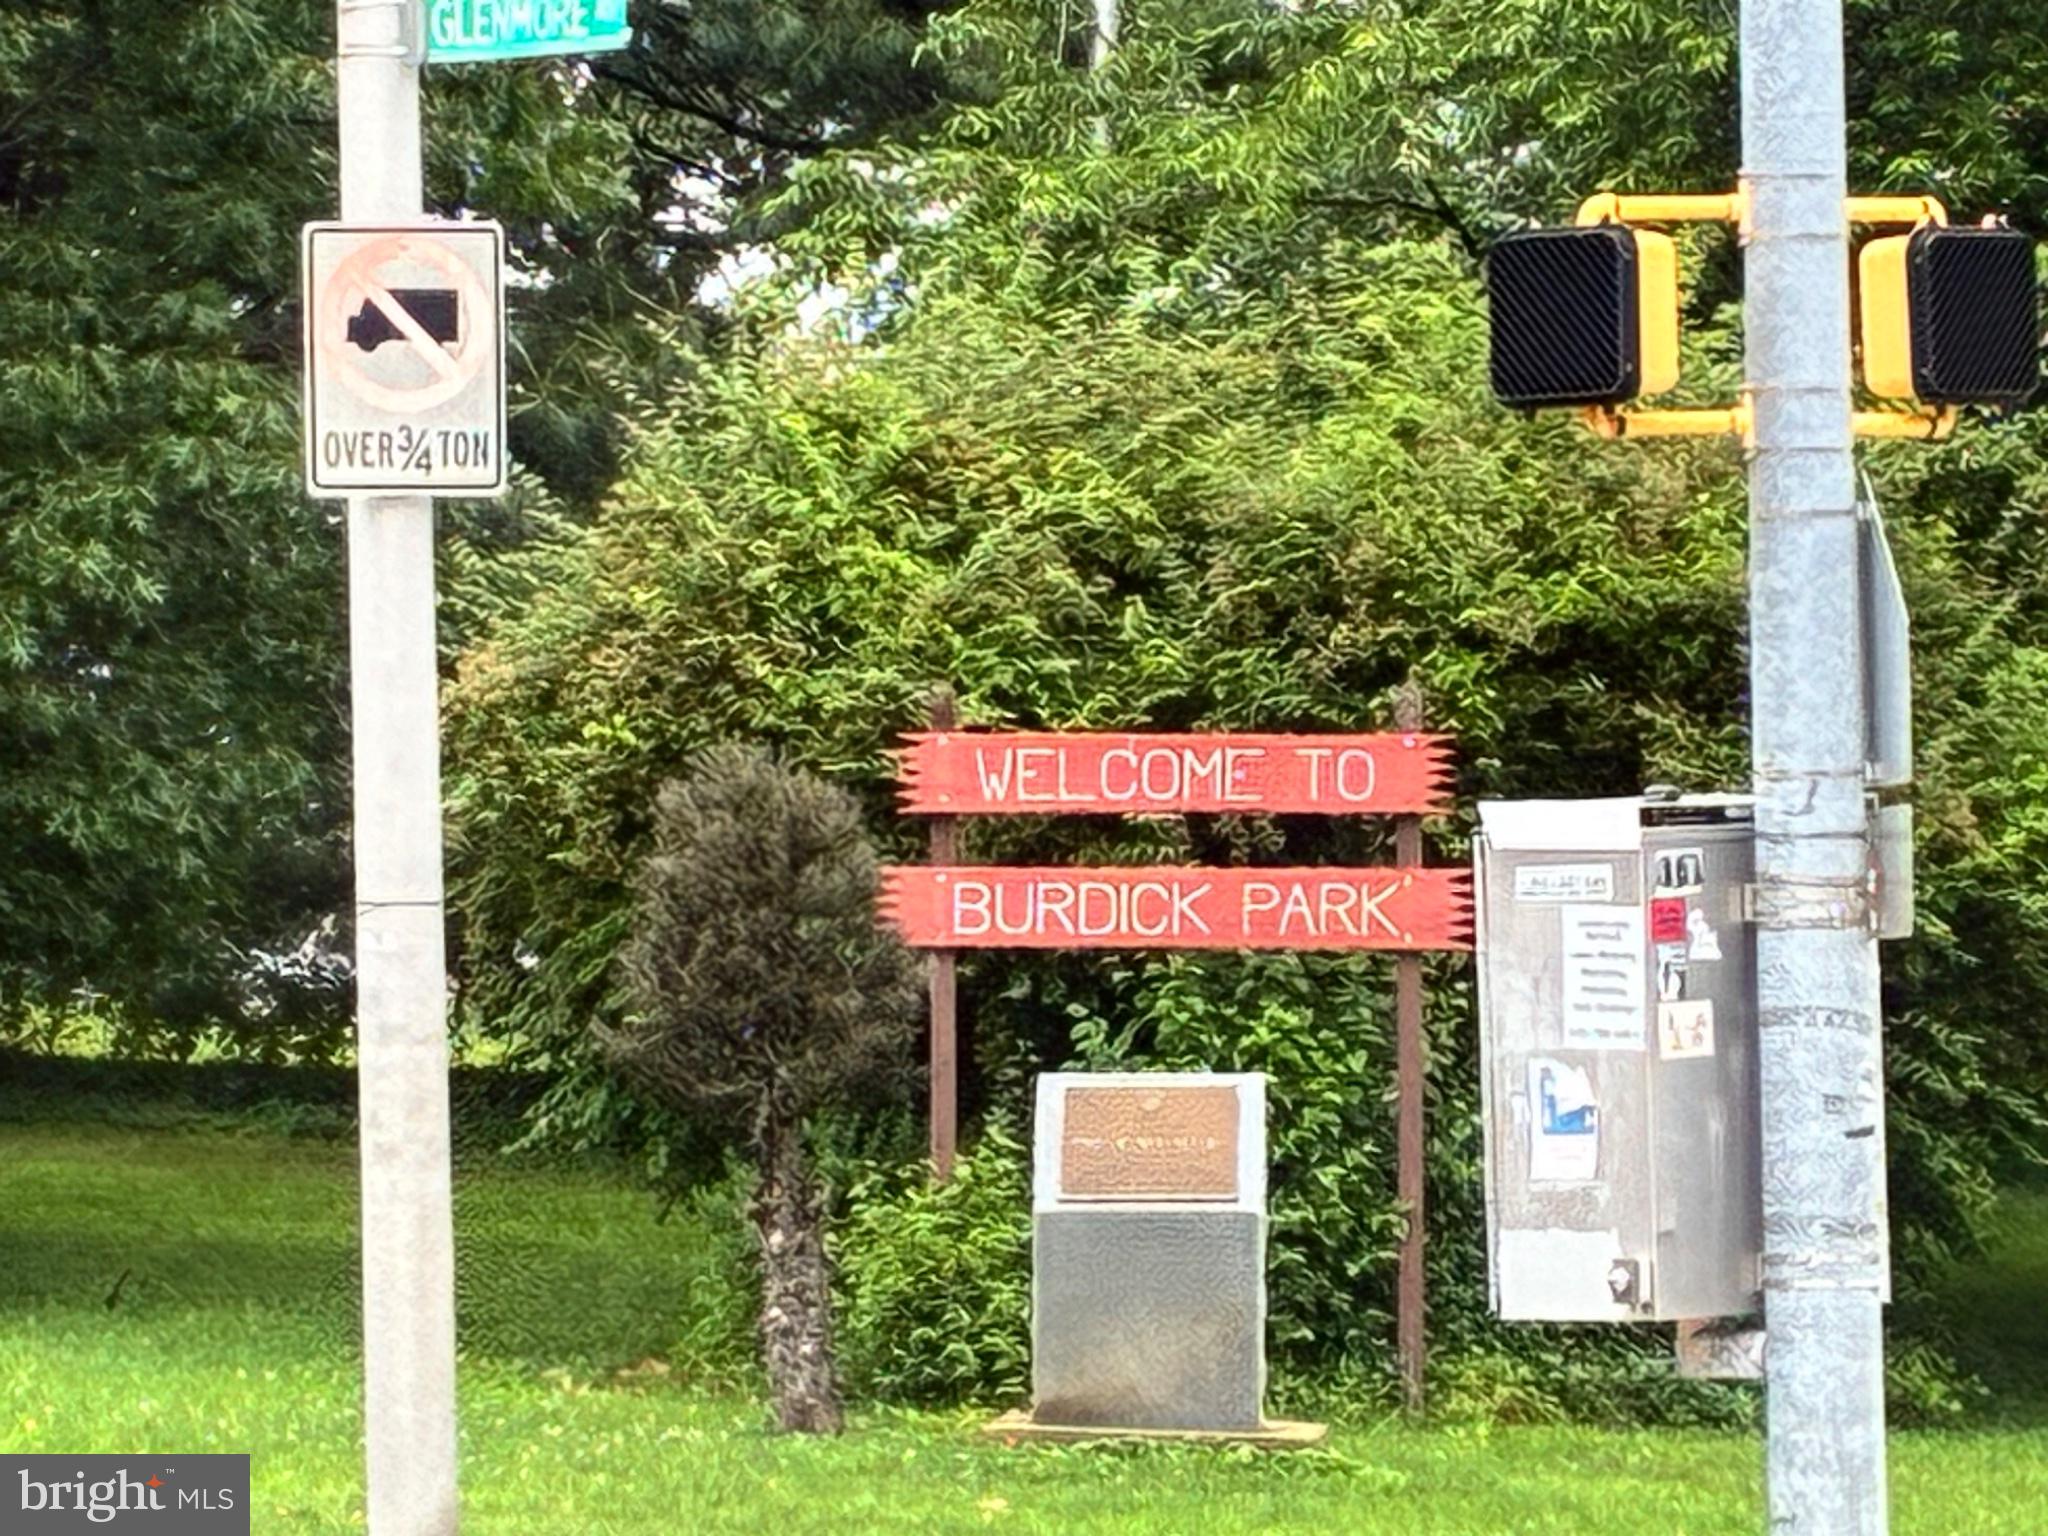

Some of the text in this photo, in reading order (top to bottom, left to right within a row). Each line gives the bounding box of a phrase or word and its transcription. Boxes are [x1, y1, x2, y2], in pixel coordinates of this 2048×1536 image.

[430, 0, 590, 46] GLENMORE
[324, 431, 394, 468] OVER
[437, 430, 489, 468] TON
[975, 747, 1375, 802] WELCOME TO
[952, 878, 1400, 938] BURDICK PARK
